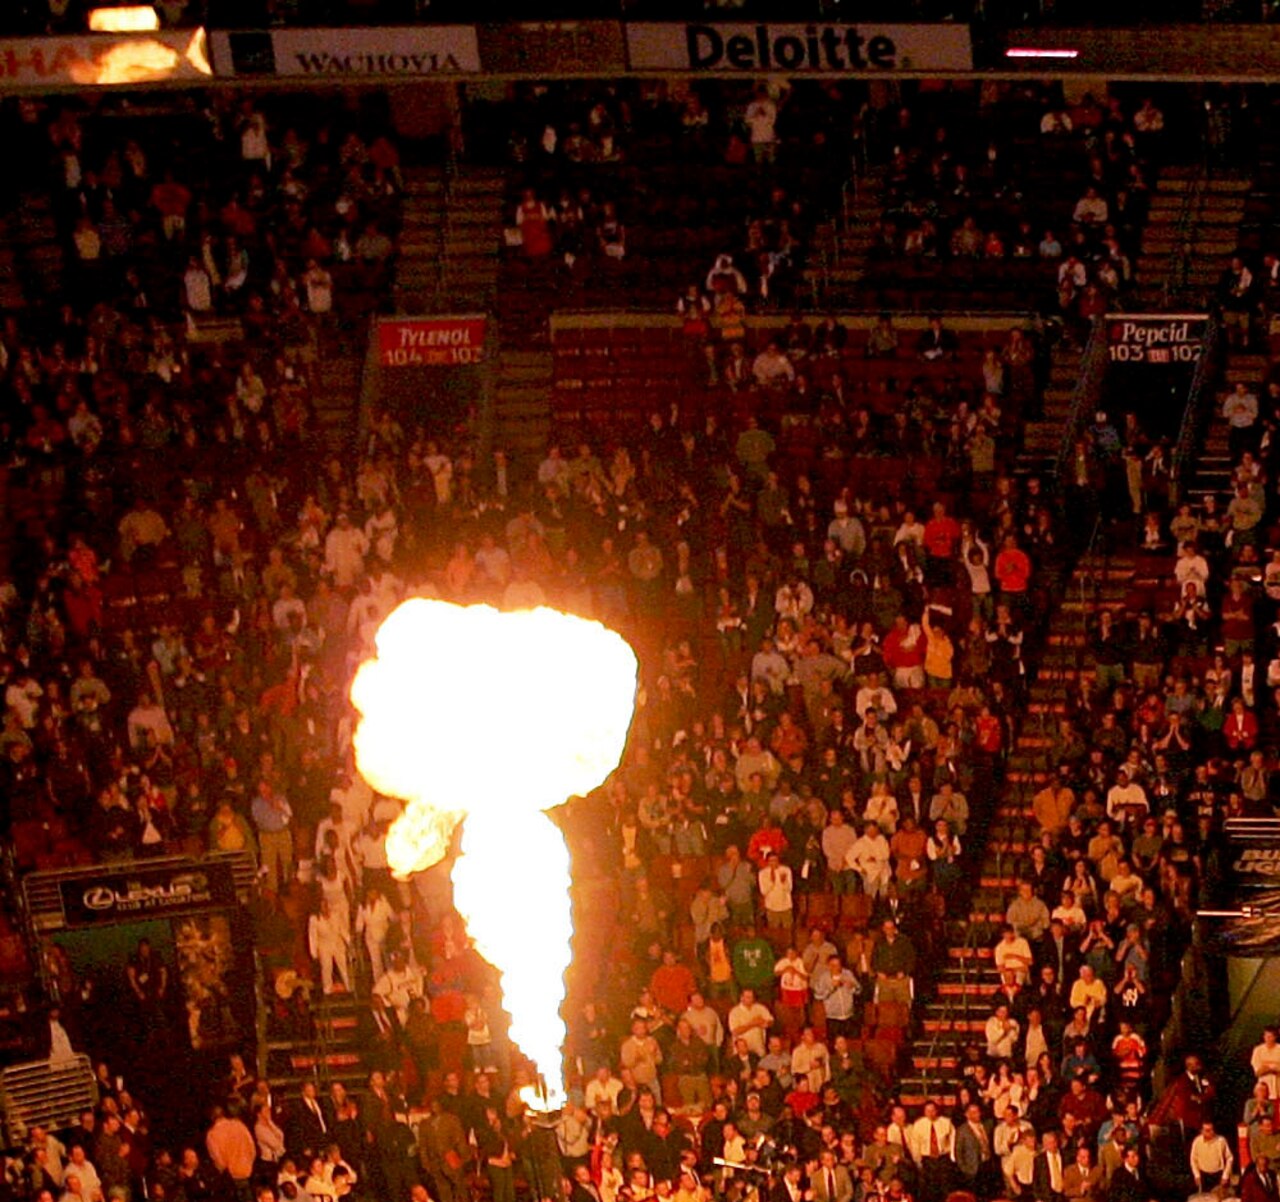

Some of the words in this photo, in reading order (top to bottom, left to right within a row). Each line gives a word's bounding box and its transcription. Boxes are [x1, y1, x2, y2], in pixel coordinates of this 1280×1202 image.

[686, 25, 896, 69] Deloitte
[296, 52, 463, 73] WACHOVIA
[397, 327, 472, 347] TYLENOL
[1121, 322, 1190, 348] Pepcid
[1108, 344, 1145, 362] 103
